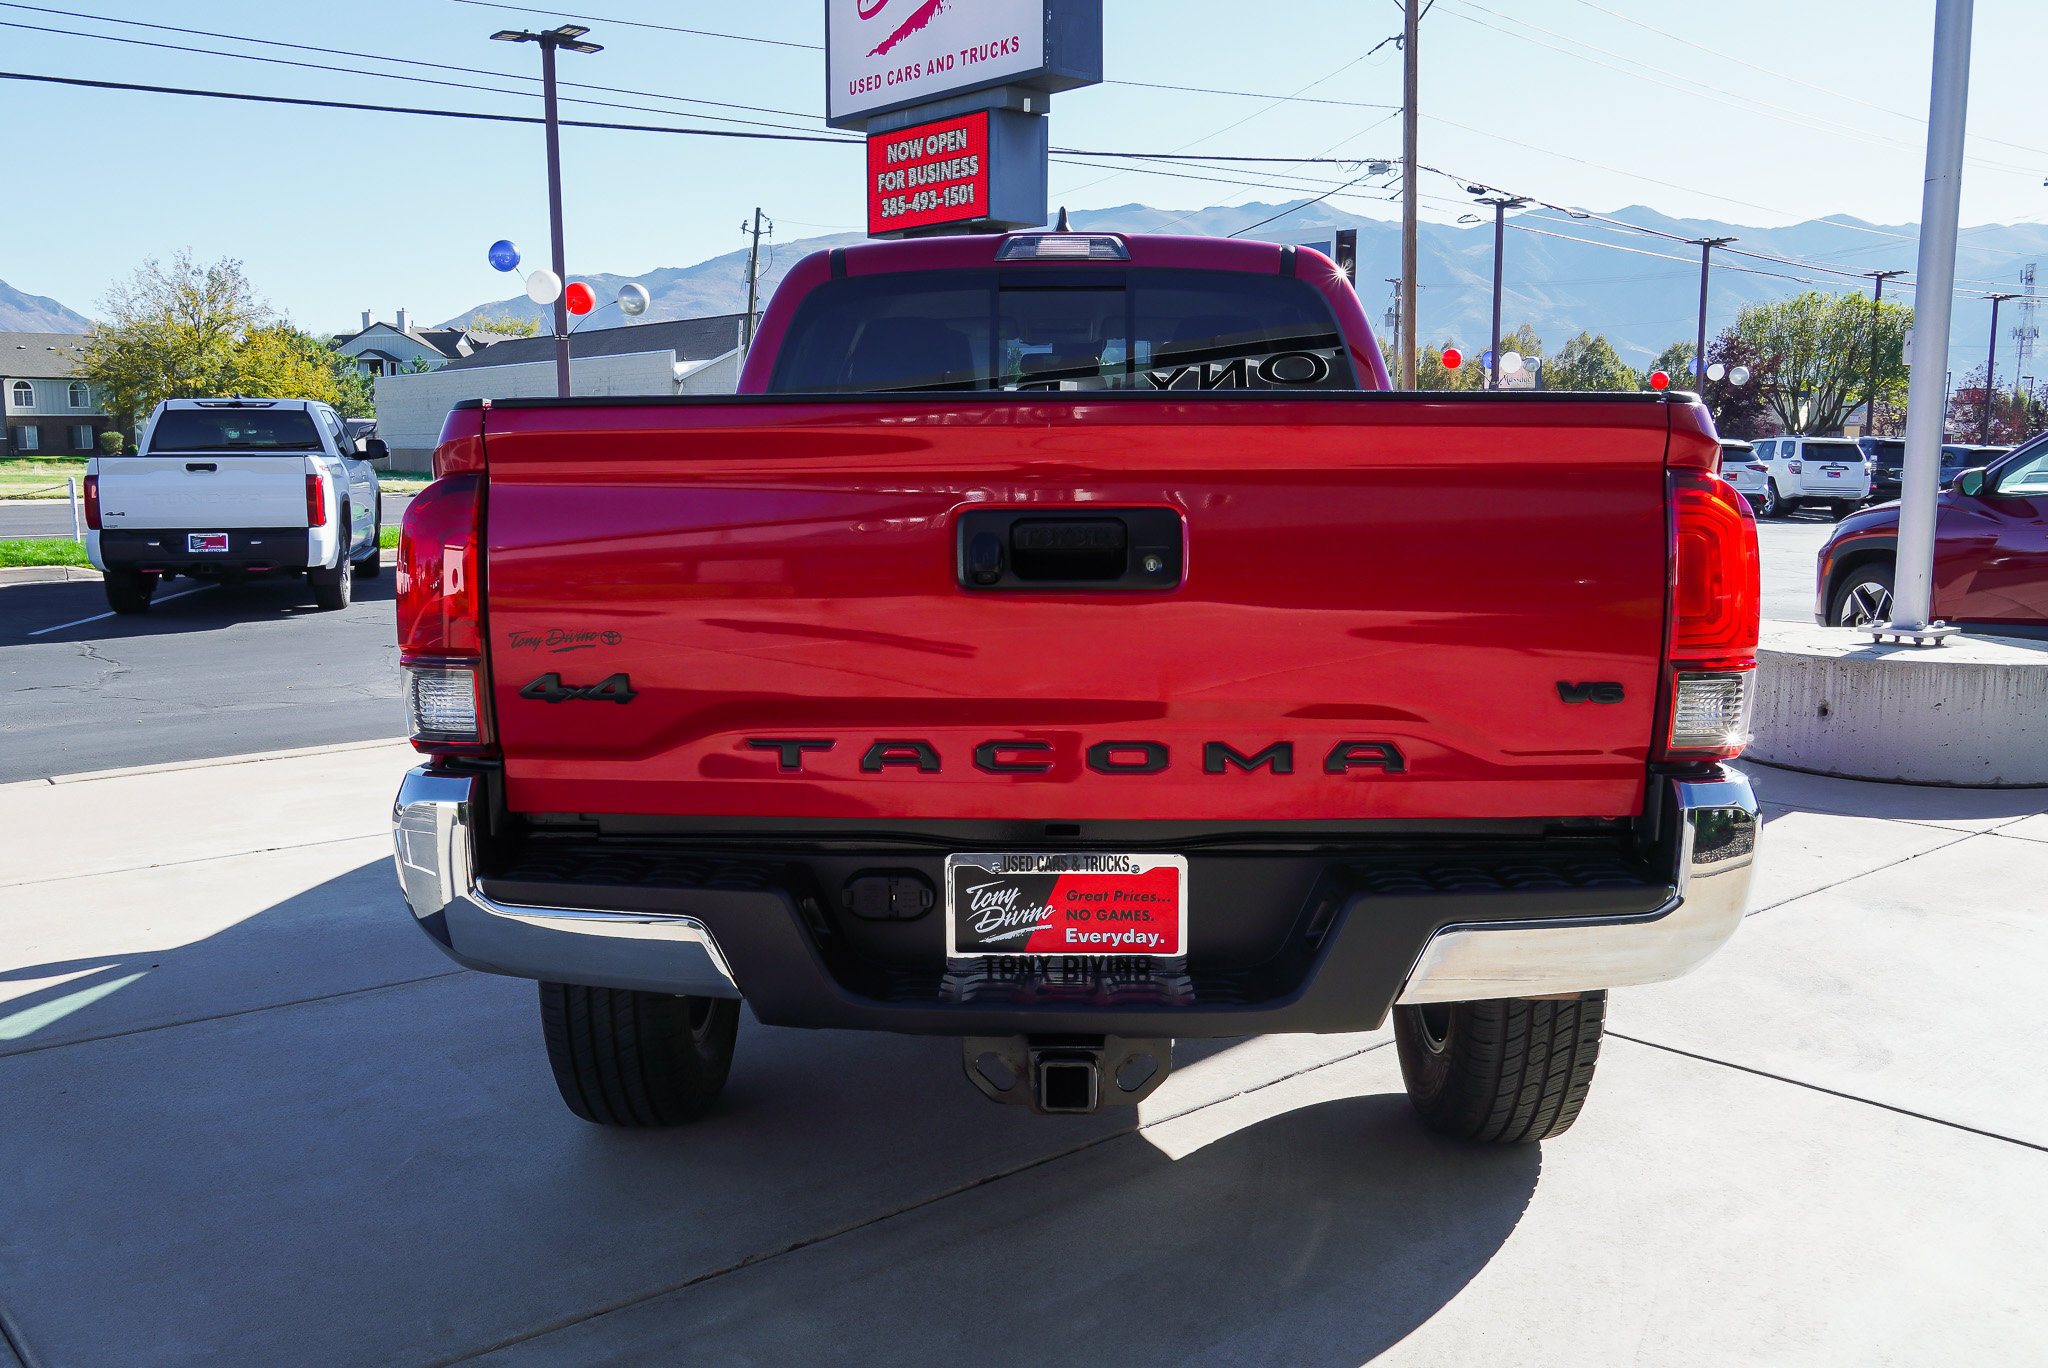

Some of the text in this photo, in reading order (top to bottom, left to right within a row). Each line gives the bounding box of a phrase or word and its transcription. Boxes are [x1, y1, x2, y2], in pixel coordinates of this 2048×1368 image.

[849, 36, 1020, 96] USED CARS AND TRUCKS
[887, 127, 968, 165] NOW OPEN
[877, 154, 979, 194] FOR BUSINESS
[881, 182, 975, 218] 385-493-1501
[508, 628, 600, 651] Tony Divino
[519, 672, 639, 704] 4x4
[1556, 681, 1625, 704] V6
[746, 738, 1407, 775] TACOMA
[1003, 855, 1130, 872] USED CARS & TRUCKS
[966, 880, 1021, 911] Tony
[1066, 889, 1172, 903] Great Prices...
[966, 901, 1057, 934] Divino
[1066, 909, 1155, 922] NO GAMES.
[1065, 927, 1166, 947] Everyday.
